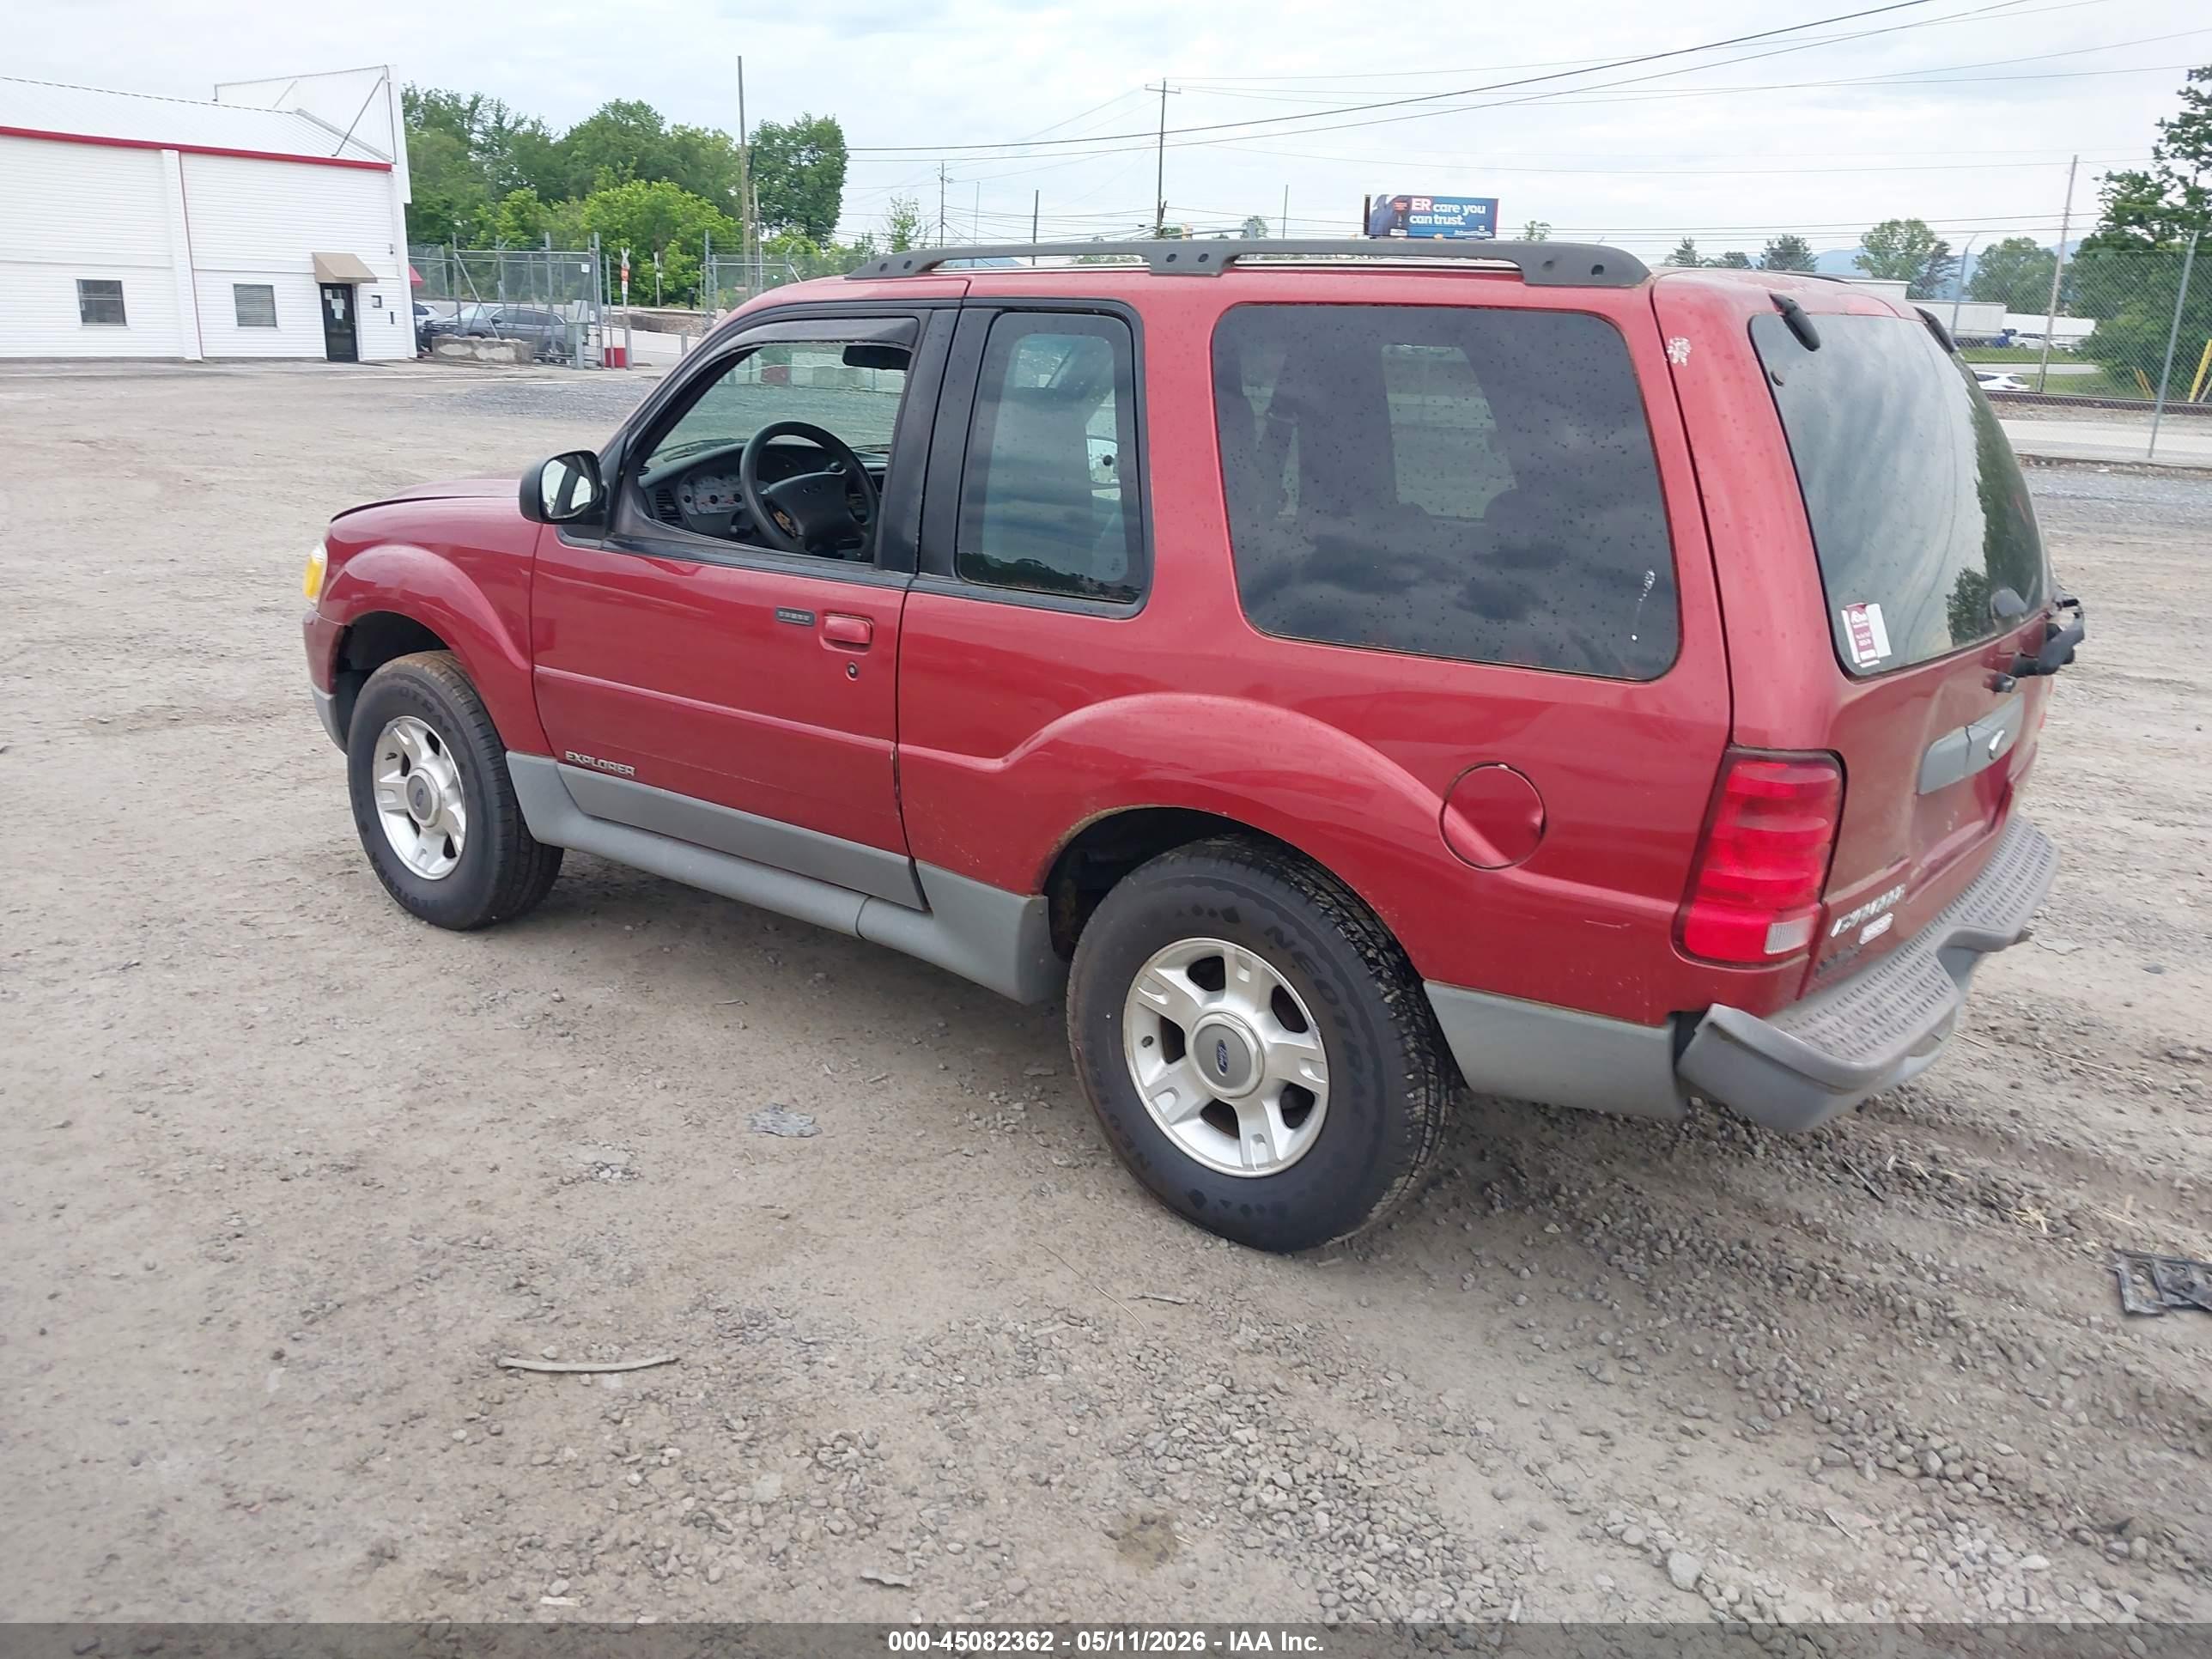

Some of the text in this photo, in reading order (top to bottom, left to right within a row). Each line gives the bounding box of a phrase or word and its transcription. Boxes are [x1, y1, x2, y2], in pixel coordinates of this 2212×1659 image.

[1411, 198, 1431, 211] ER
[1433, 204, 1461, 214] care
[1462, 204, 1486, 216] you
[1409, 215, 1466, 226] can trust.
[565, 750, 635, 776] EXPLORER
